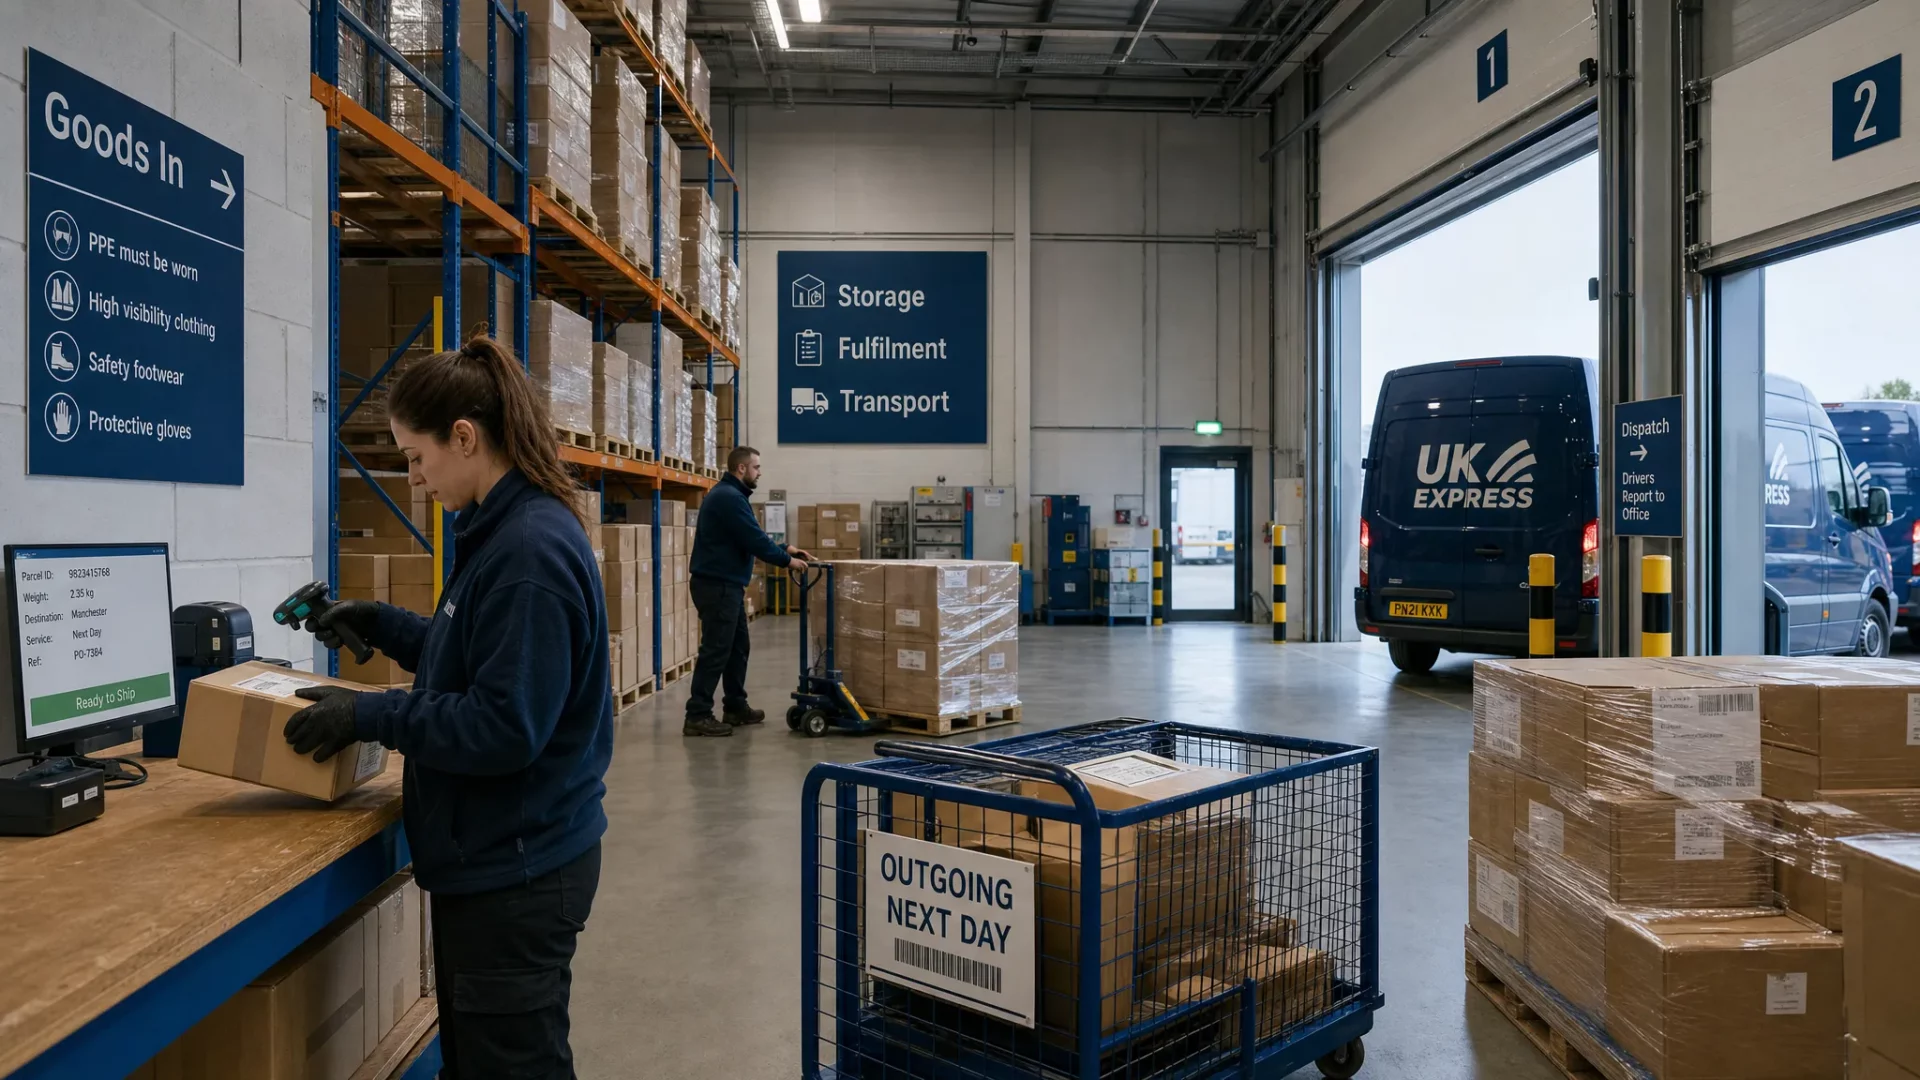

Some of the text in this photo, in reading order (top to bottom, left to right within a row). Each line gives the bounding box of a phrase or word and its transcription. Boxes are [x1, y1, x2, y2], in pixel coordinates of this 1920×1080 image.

[1486, 46, 1495, 88] 1
[1853, 79, 1877, 143] 2
[45, 91, 184, 189] Goods In
[89, 232, 198, 282] PPE must be worn
[838, 284, 925, 313] Storage
[89, 290, 216, 342] High visibility clothing
[839, 336, 947, 360] Fulfilment
[89, 351, 184, 386] Safety footwear
[840, 389, 950, 418] Transport
[89, 410, 192, 442] Protective gloves
[1622, 417, 1670, 440] Dispatch
[1416, 442, 1486, 484] UK
[1622, 471, 1655, 485] Drivers
[1413, 487, 1534, 509] EXPRESS
[1622, 490, 1665, 505] Report to
[1622, 507, 1650, 520] Office
[21, 567, 111, 581] Parcel ID: 9823415768
[23, 588, 94, 605] Weight: 2.35 kg
[25, 608, 108, 625] Destination: Manchester
[1394, 603, 1443, 618] PN21 KXK
[26, 627, 102, 646] Service: Next Day
[28, 657, 43, 668] Ref:
[76, 687, 136, 710] Ready to Ship
[880, 852, 1013, 910] OUTGOING
[887, 895, 1012, 954] NEXT DAY
